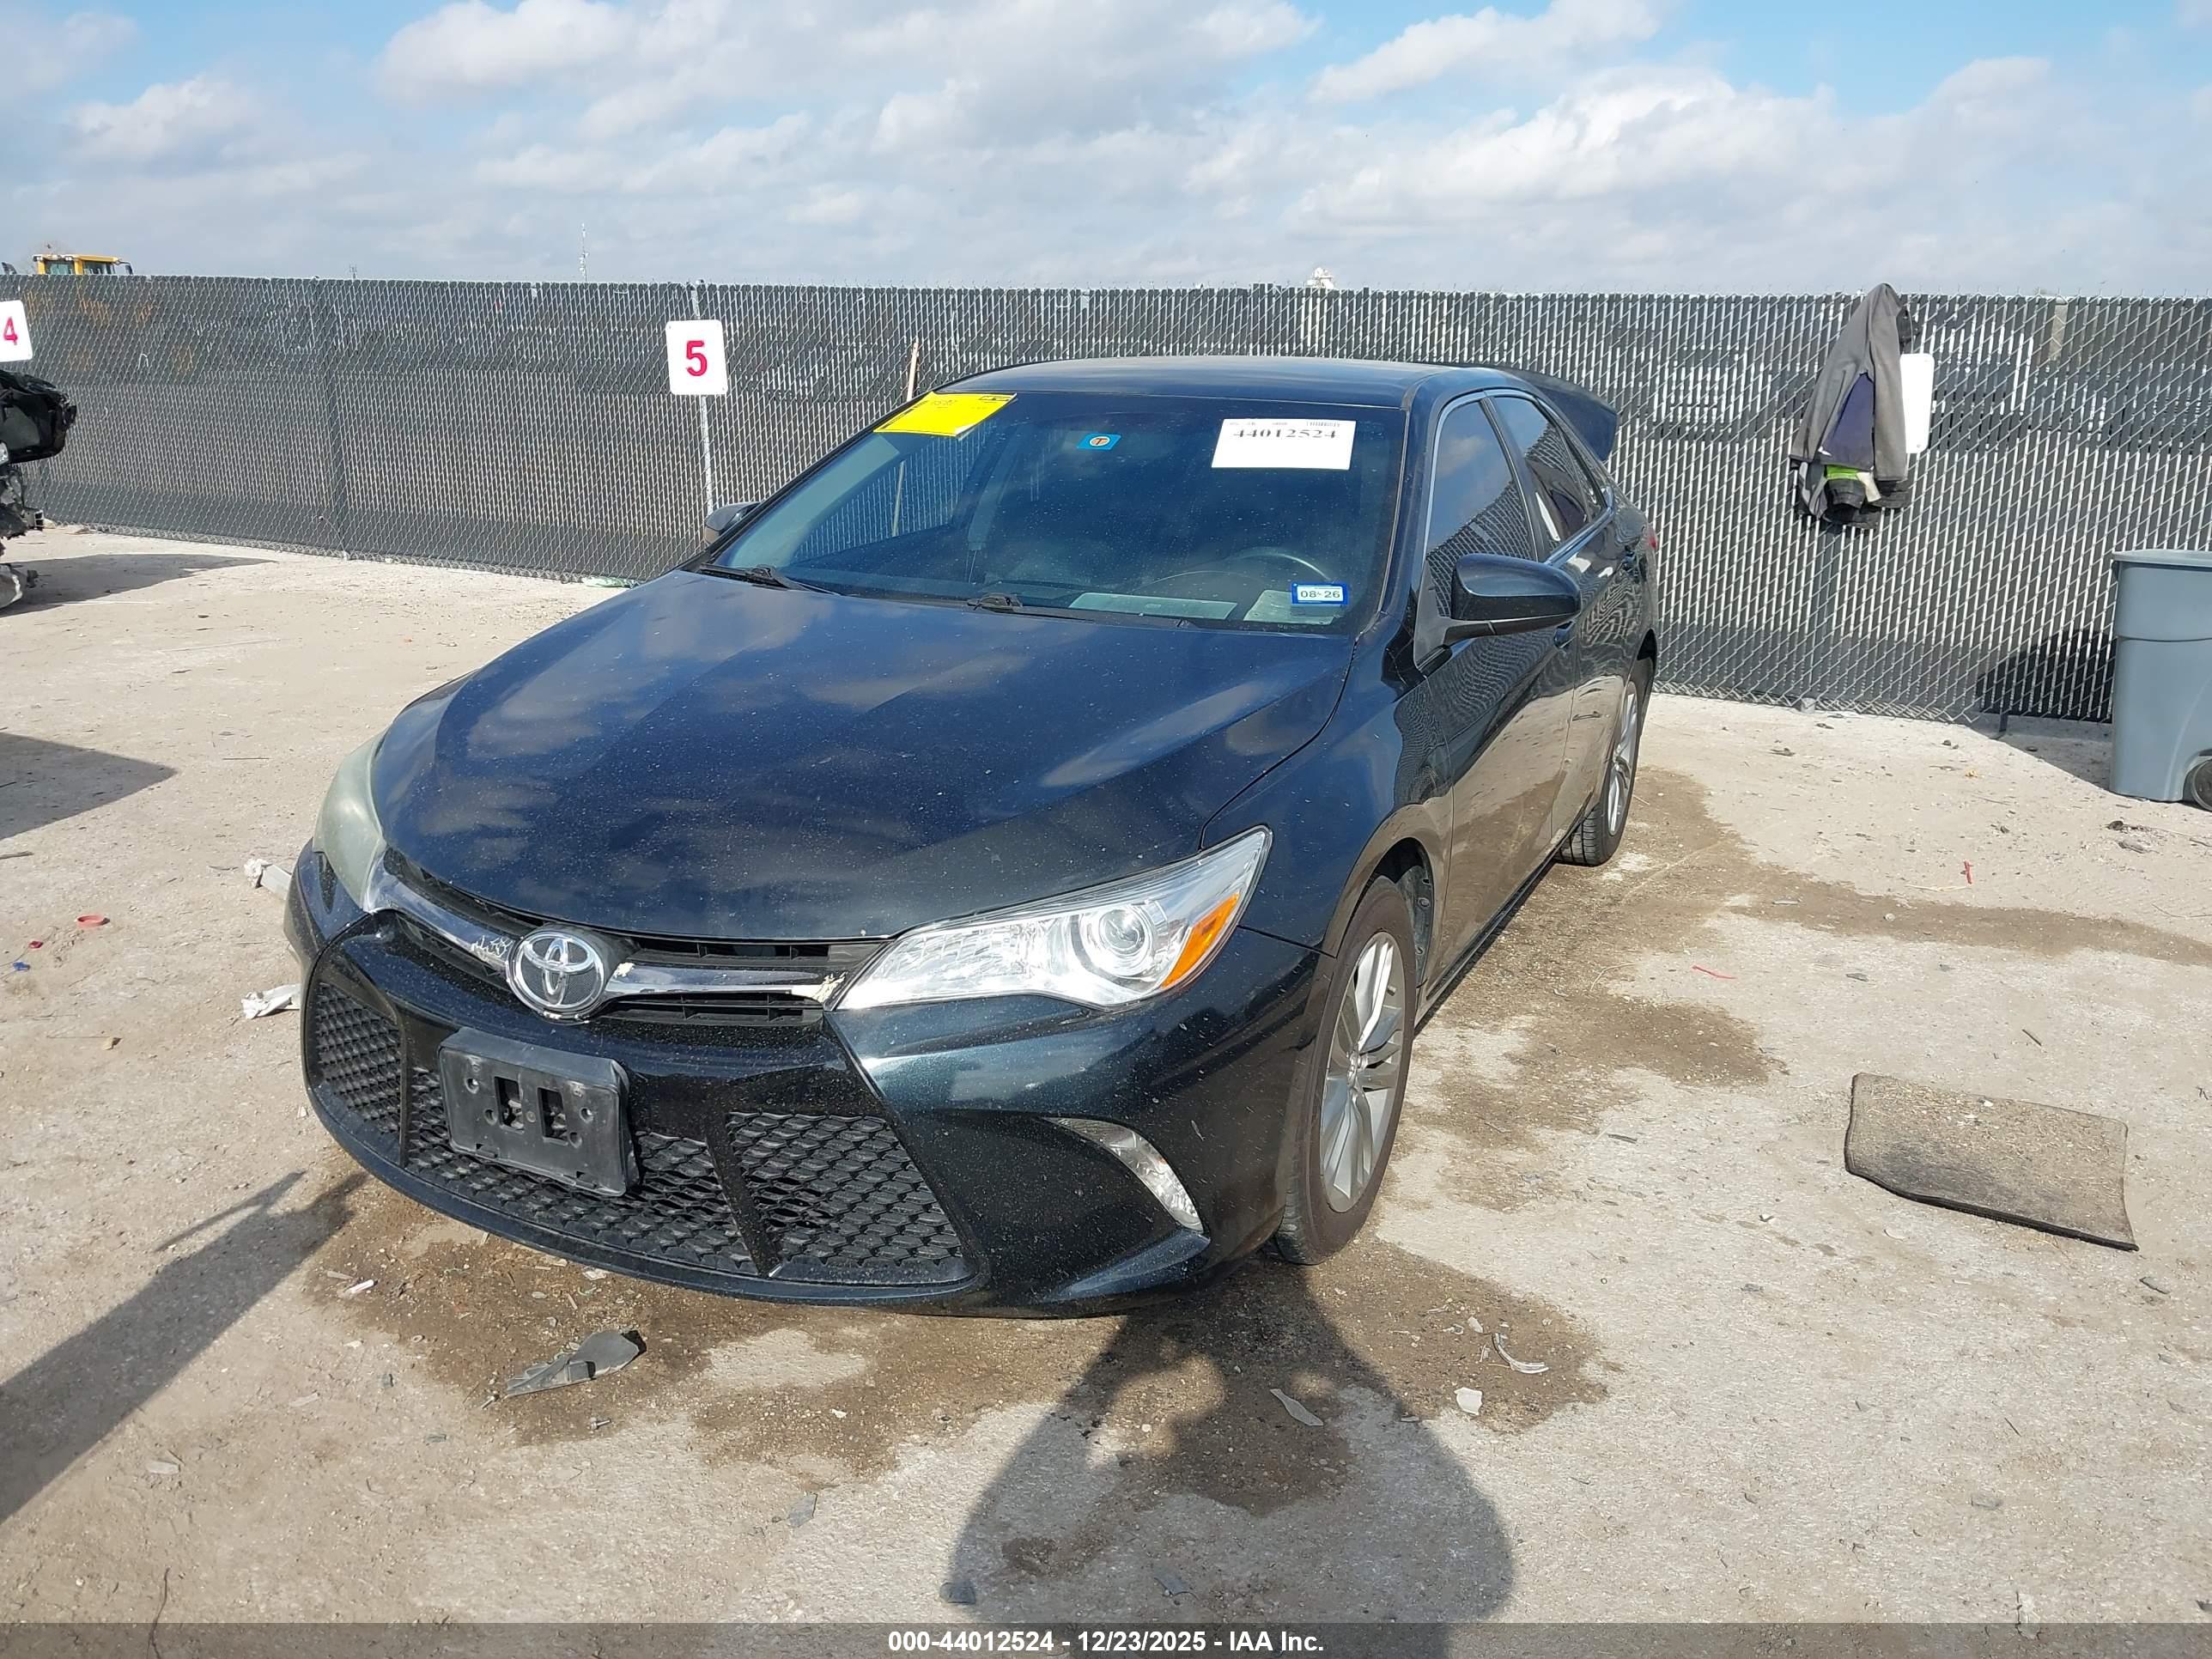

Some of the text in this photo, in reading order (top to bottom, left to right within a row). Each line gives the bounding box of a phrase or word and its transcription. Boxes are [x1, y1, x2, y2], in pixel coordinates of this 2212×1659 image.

[3, 317, 18, 345] 4
[687, 340, 707, 376] 5
[1232, 428, 1338, 439] 44012524
